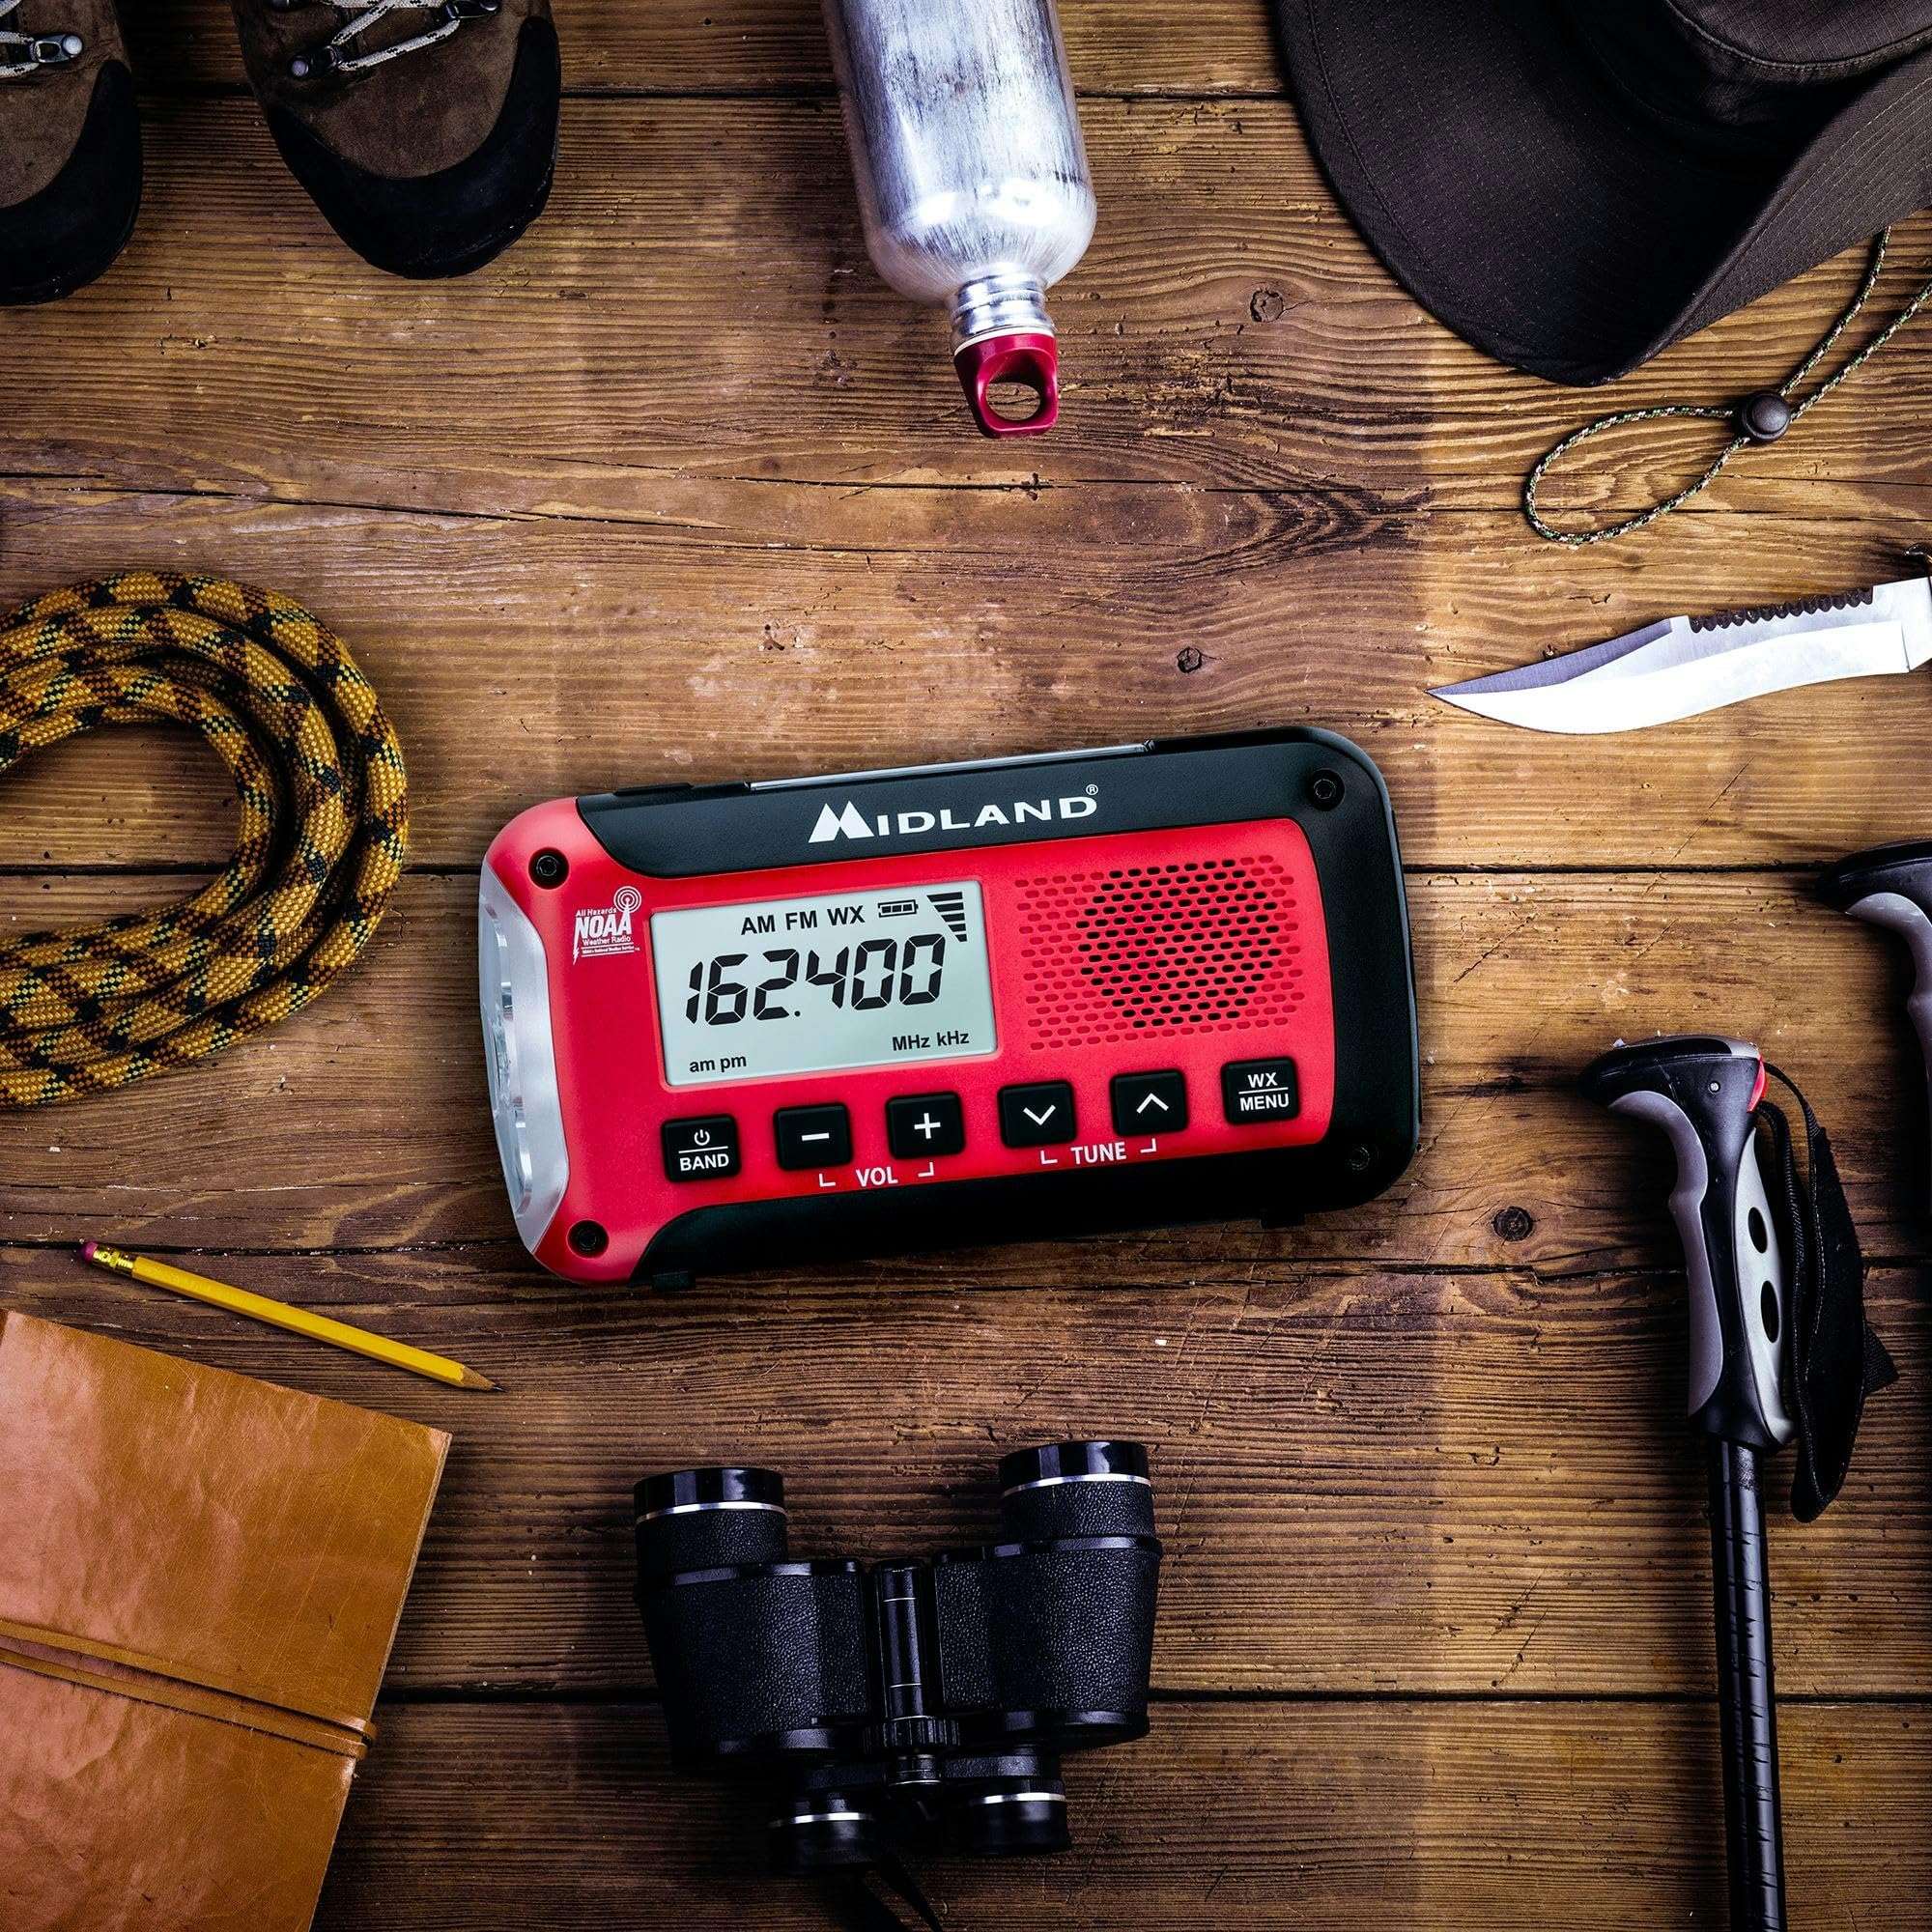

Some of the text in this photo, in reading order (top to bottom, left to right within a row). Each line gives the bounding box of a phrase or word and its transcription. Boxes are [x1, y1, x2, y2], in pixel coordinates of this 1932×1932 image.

[574, 910, 633, 942] NOAA
[741, 905, 866, 936] AM FM WX
[582, 935, 631, 946] Weather Radio
[685, 932, 946, 1026] 162.400
[892, 1030, 970, 1052] MHz kHz
[689, 1055, 747, 1073] am pm
[1247, 1071, 1277, 1088] WX
[1239, 1093, 1290, 1112] MENU
[679, 1152, 729, 1171] BAND
[1070, 1141, 1127, 1165] TUNE
[856, 1166, 898, 1187] VOL
